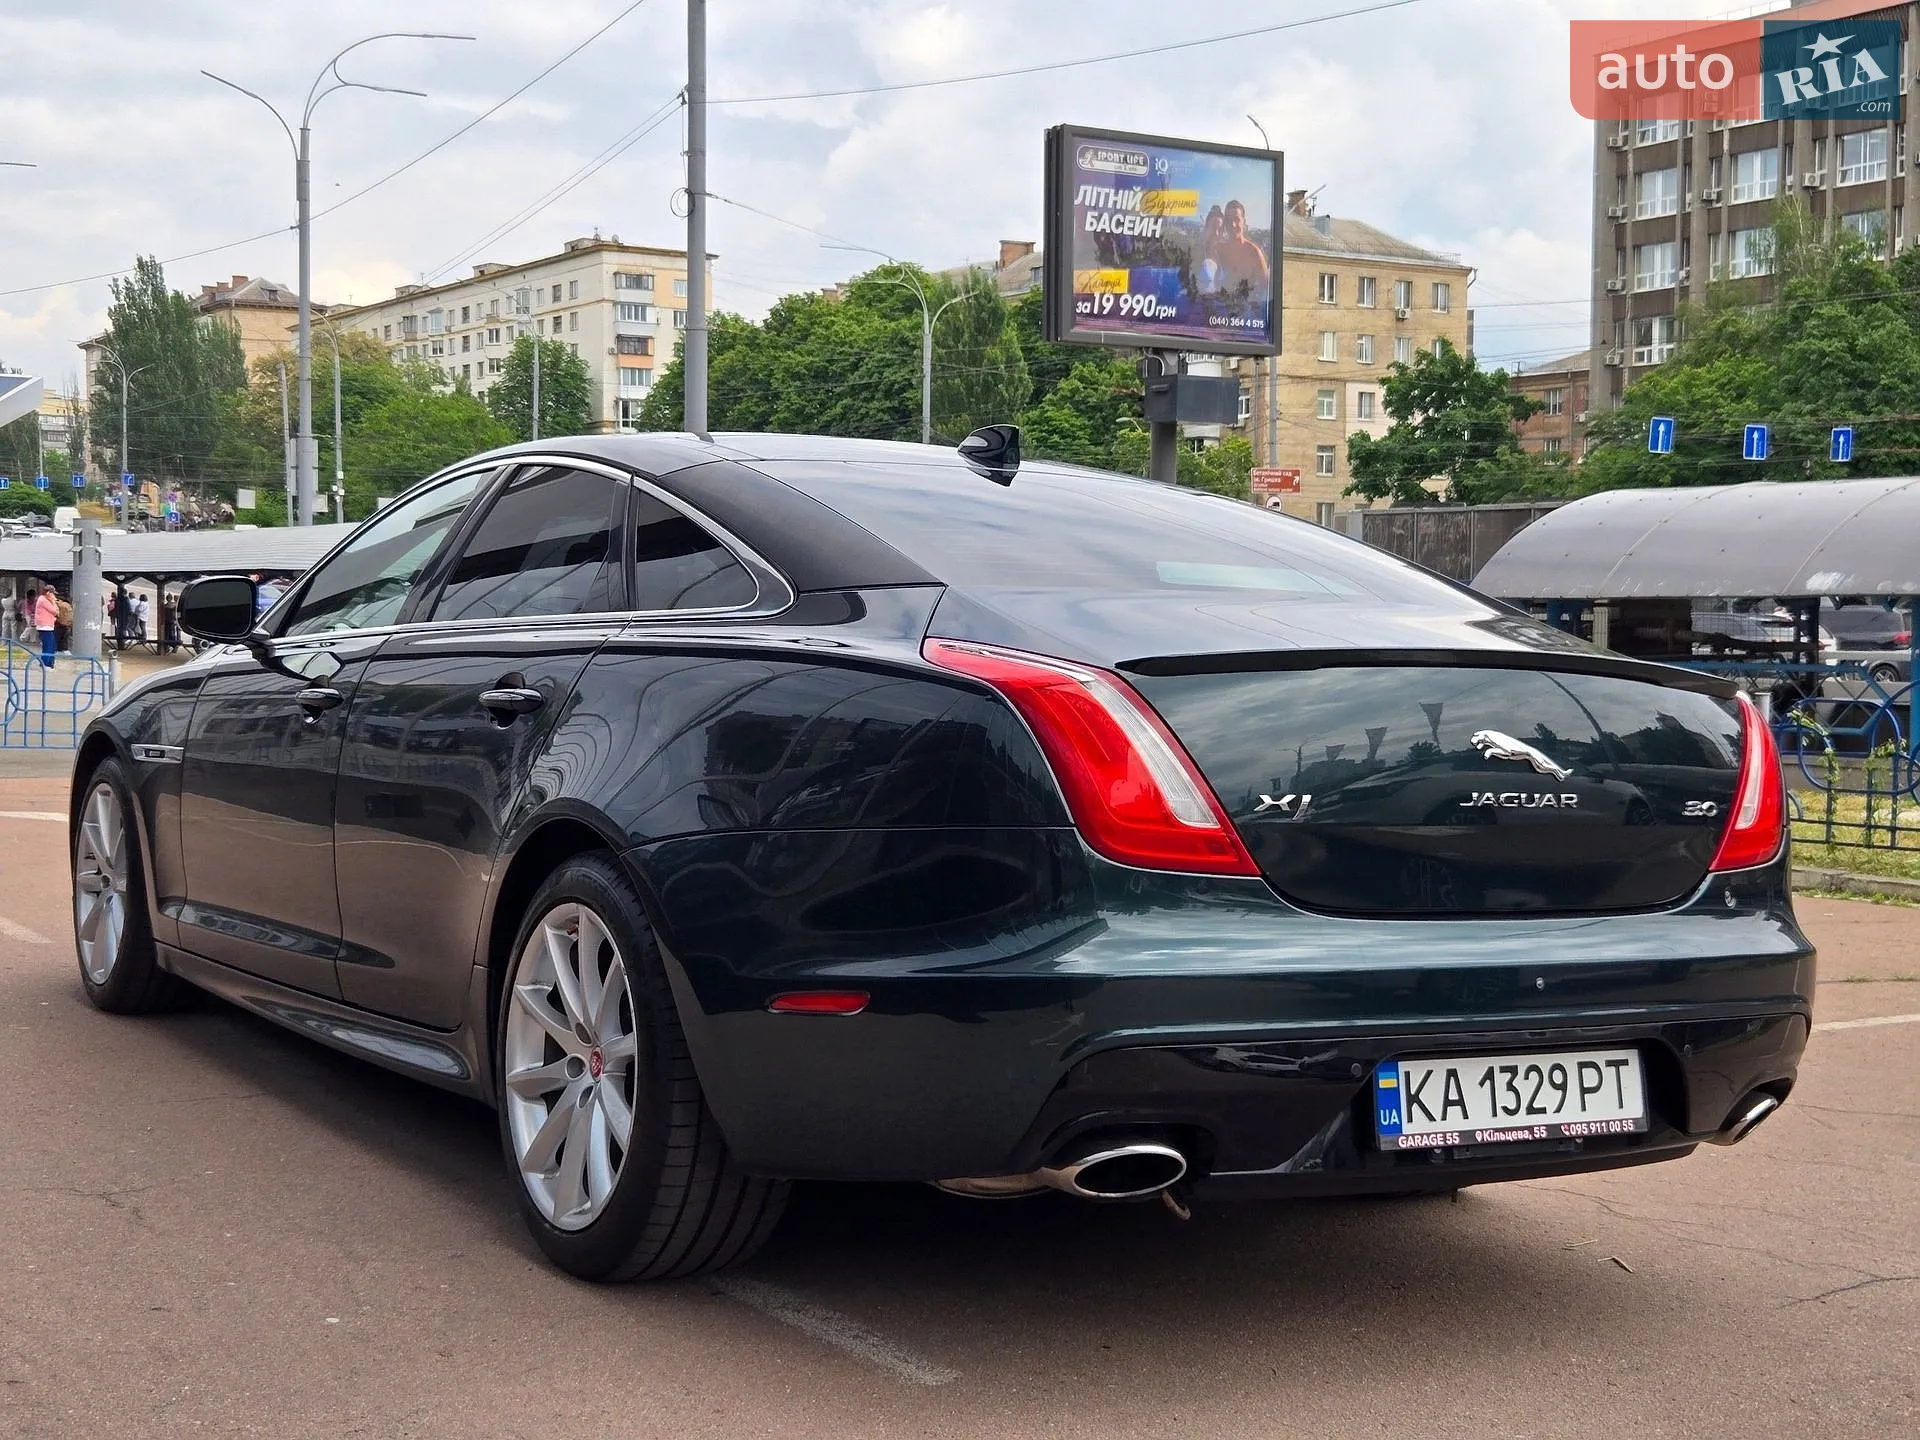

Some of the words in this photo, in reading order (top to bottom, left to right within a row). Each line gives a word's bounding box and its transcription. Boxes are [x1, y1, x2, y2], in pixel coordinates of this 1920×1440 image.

[1097, 151, 1125, 164] SPORT
[1126, 154, 1145, 166] LIFE
[1074, 184, 1142, 212] ЛІТНІЙ
[1085, 212, 1163, 238] БАСЕЙН
[1076, 301, 1091, 315] за
[1093, 292, 1114, 315] 19
[1119, 294, 1156, 318] 990
[1156, 305, 1176, 320] грн
[1209, 315, 1229, 328] (044)
[1230, 317, 1245, 327] 364
[1253, 794, 1312, 820] XJ
[1459, 792, 1578, 808] JAGUAR
[1404, 1067, 1469, 1123] KA
[1478, 1063, 1568, 1118] 1329
[1576, 1059, 1630, 1112] PT
[1380, 1109, 1400, 1125] UA
[1483, 1128, 1532, 1141] Кільцева,
[1533, 1126, 1546, 1138] 55
[1569, 1123, 1588, 1135] 095
[1589, 1121, 1607, 1133] 911
[1609, 1120, 1620, 1132] 00
[1622, 1119, 1634, 1131] 55
[1398, 1133, 1445, 1148] GARAGE
[1445, 1132, 1460, 1144] 55
